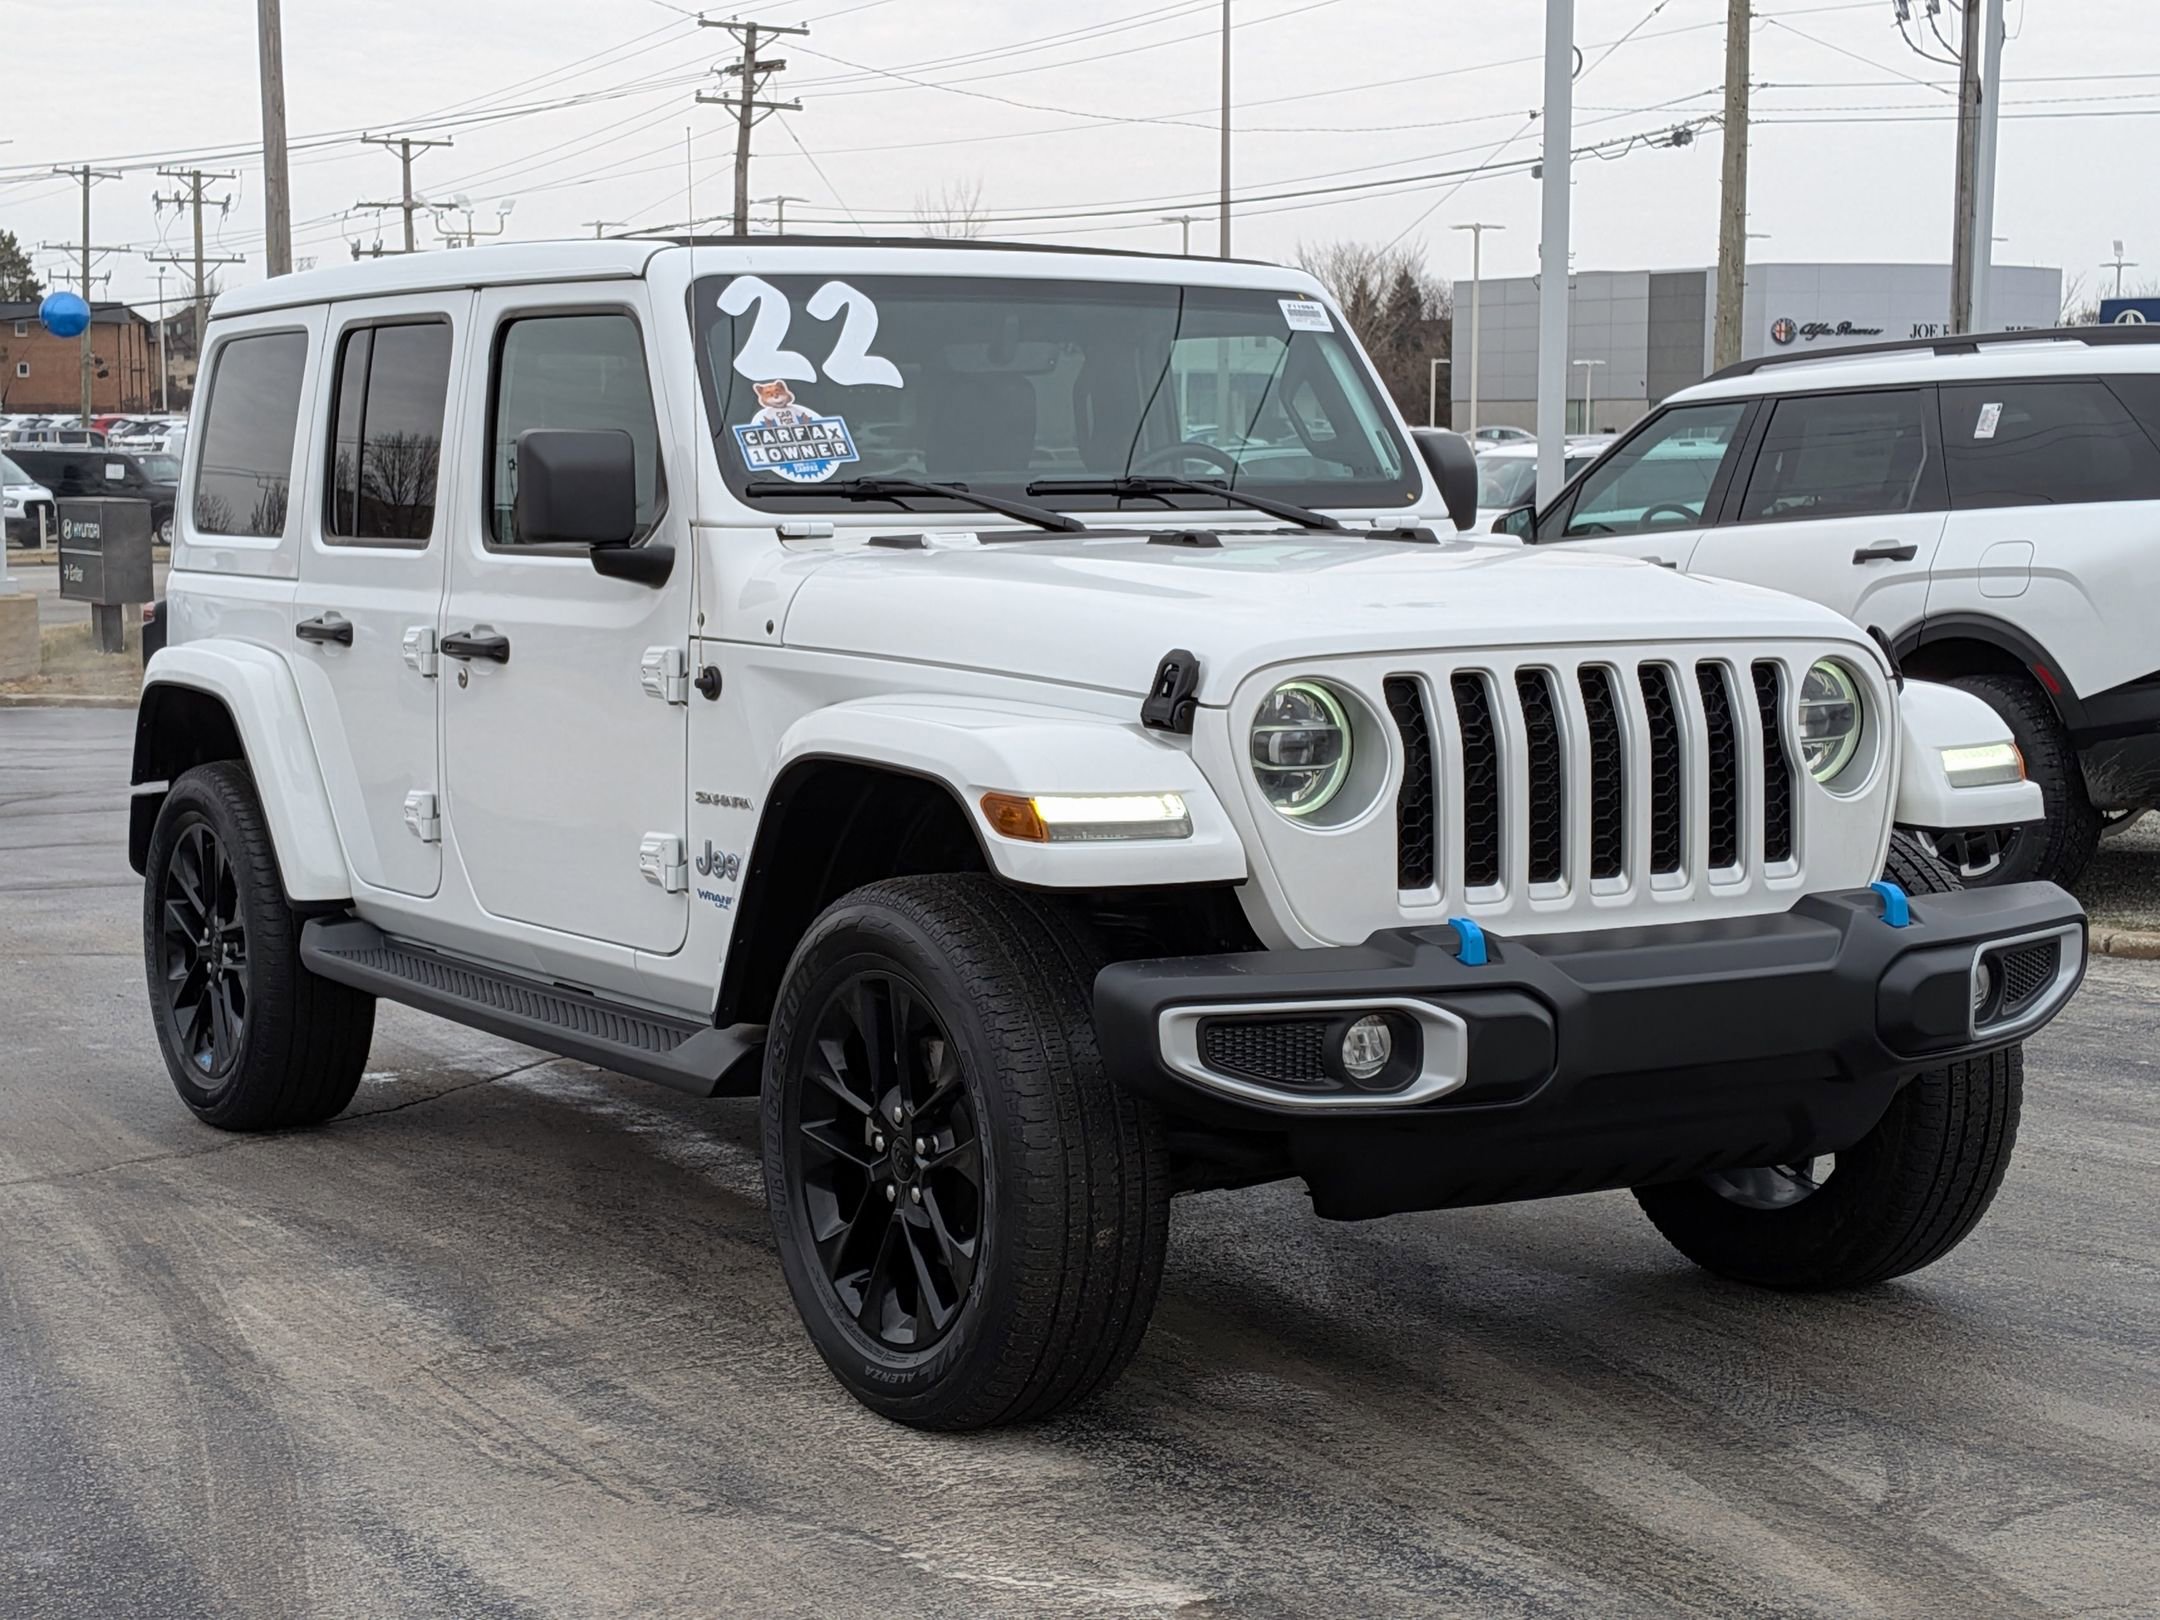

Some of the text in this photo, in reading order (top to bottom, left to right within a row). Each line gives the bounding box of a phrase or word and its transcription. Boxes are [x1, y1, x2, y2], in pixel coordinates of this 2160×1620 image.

[717, 275, 904, 389] 22
[1799, 322, 1835, 341] Alfa
[1836, 321, 1884, 336] Romeo
[745, 424, 844, 446] CARFAX
[753, 443, 848, 462] 1 OWNER
[864, 1365, 917, 1384] ALENZA
